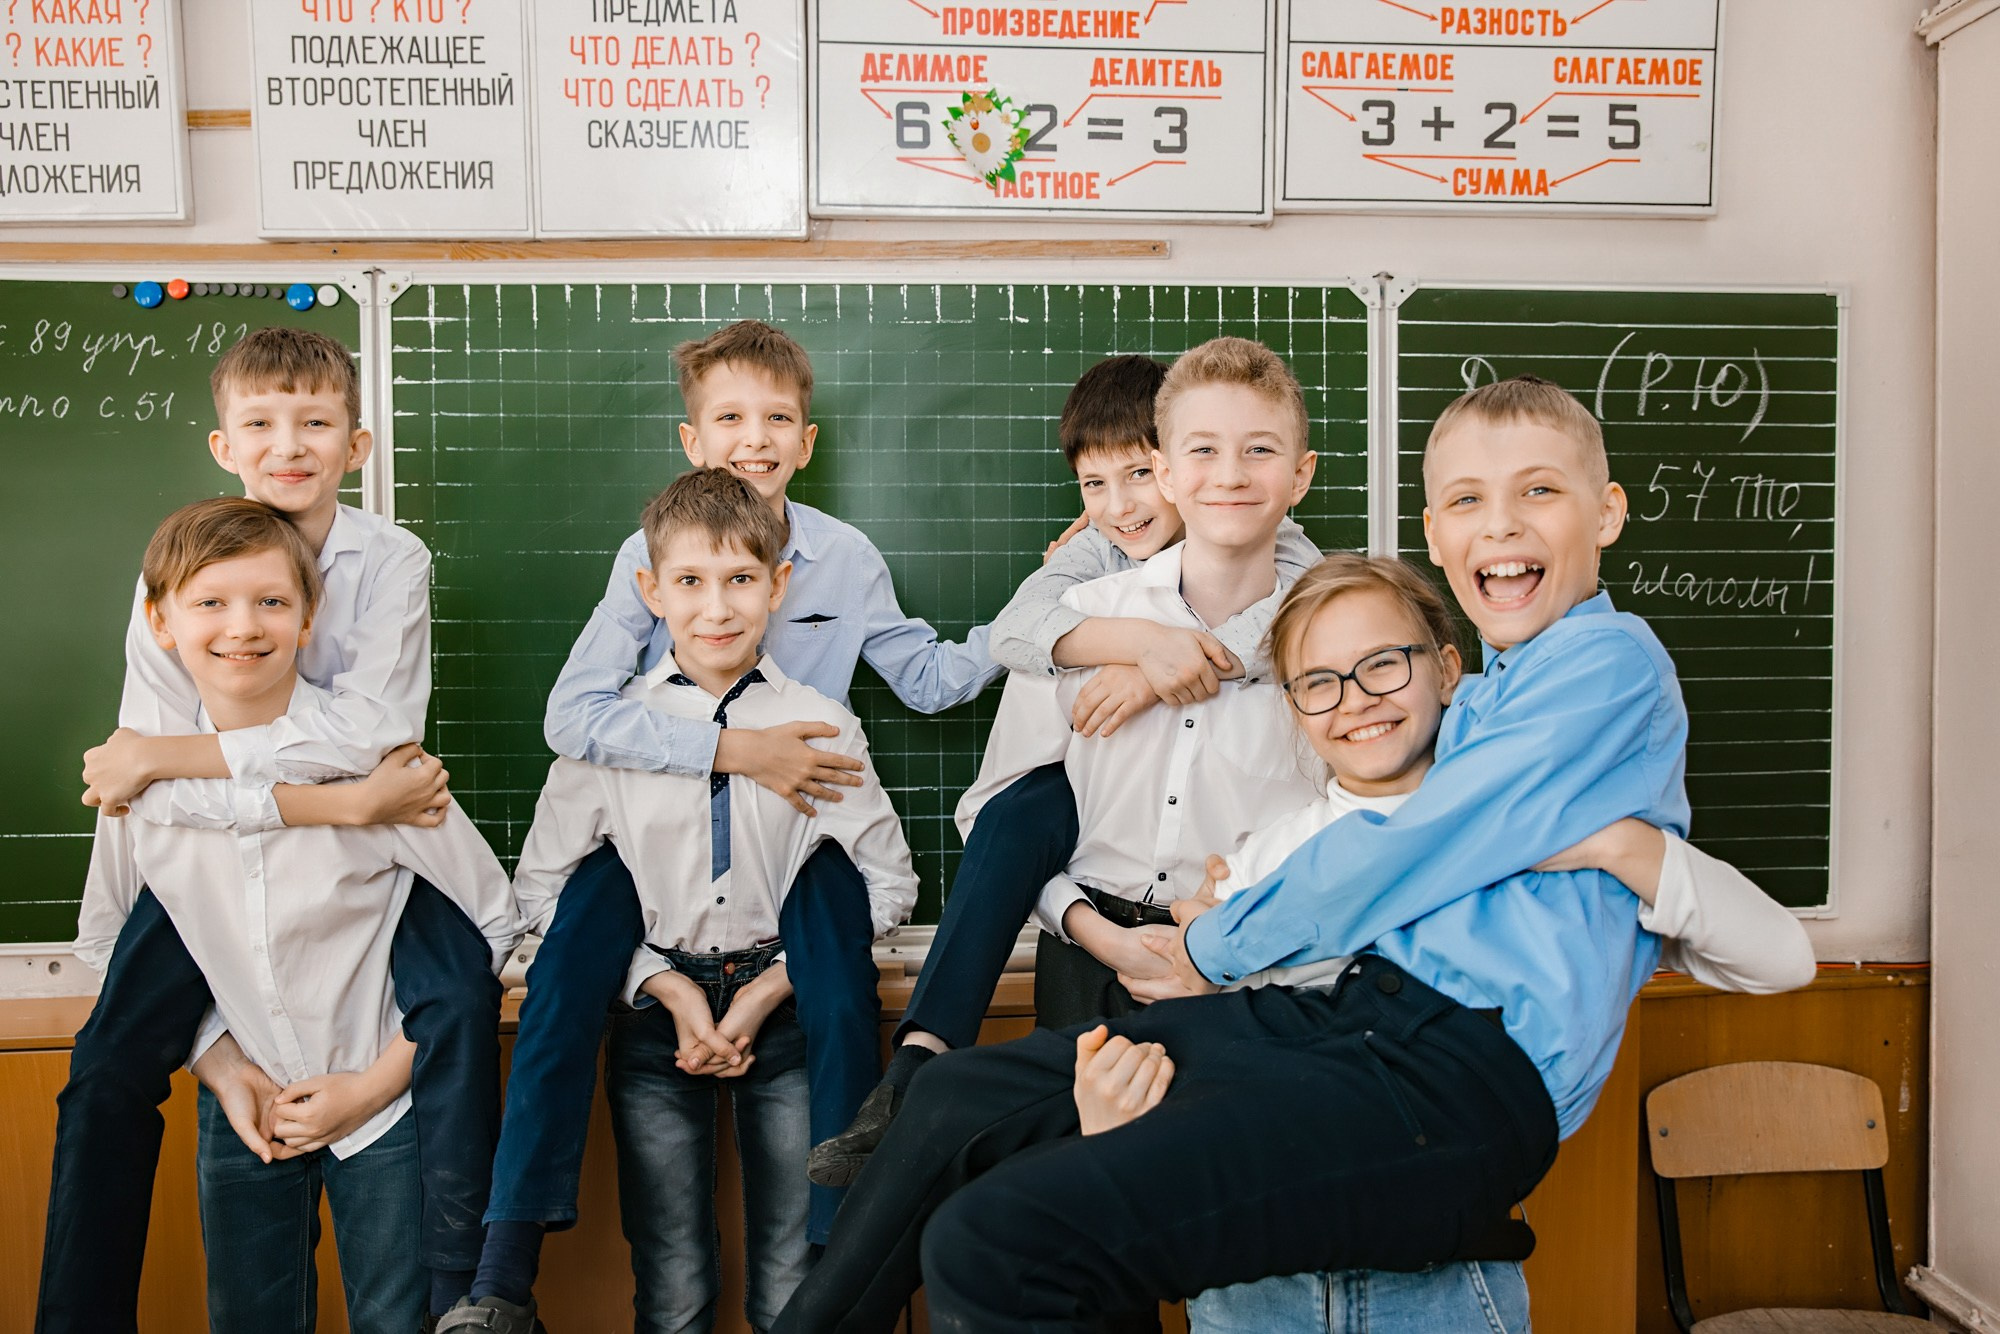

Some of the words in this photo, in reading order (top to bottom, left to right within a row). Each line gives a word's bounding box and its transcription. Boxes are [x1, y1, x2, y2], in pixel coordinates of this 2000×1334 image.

[32, 0, 121, 24] КАКАЯ
[302, 0, 352, 23] ЧТО
[394, 0, 443, 23] КТО
[593, 0, 737, 27] ПРЕДМЕТА
[943, 8, 1139, 39] ПРОИЗВЕДЕНИЕ
[1441, 7, 1567, 36] РАЗНОСТЬ
[6, 33, 21, 66] ?
[35, 37, 124, 67] КАКИЕ
[138, 34, 151, 68] ?
[291, 35, 486, 69] ПОДЛЕЖАЩЕЕ
[570, 36, 619, 65] ЧТО
[632, 36, 732, 69] ДЕЛАТЬ
[745, 32, 760, 67] ?
[1302, 51, 1454, 80] СЛАГАЕМОЕ
[861, 53, 987, 83] ДЕЛИМОЕ
[1090, 58, 1222, 87] ДЕЛИТЕЛЬ
[1554, 57, 1702, 86] СЛАГАЕМОЕ
[267, 73, 513, 106] ВТОРОСТЕПЕННЫЙ
[565, 79, 613, 107] ЧТО
[627, 78, 743, 111] СДЕЛАТЬ
[756, 75, 770, 108] ?
[0, 122, 70, 152] ЧЛЕН
[358, 119, 426, 148] ЧЛЕН
[588, 120, 749, 149] СКАЗУЕМОЕ
[896, 101, 930, 149] 6
[1023, 104, 1058, 152] 2
[1153, 106, 1188, 154] 3
[1362, 100, 1395, 146] 3
[1484, 102, 1517, 149] 2
[1608, 104, 1641, 150] 5
[0, 164, 140, 197] ЛОЖЕНИЯ
[294, 161, 493, 194] ПРЕДЛОЖЕНИЯ
[1453, 168, 1549, 196] СУММА
[30, 319, 72, 354] 89
